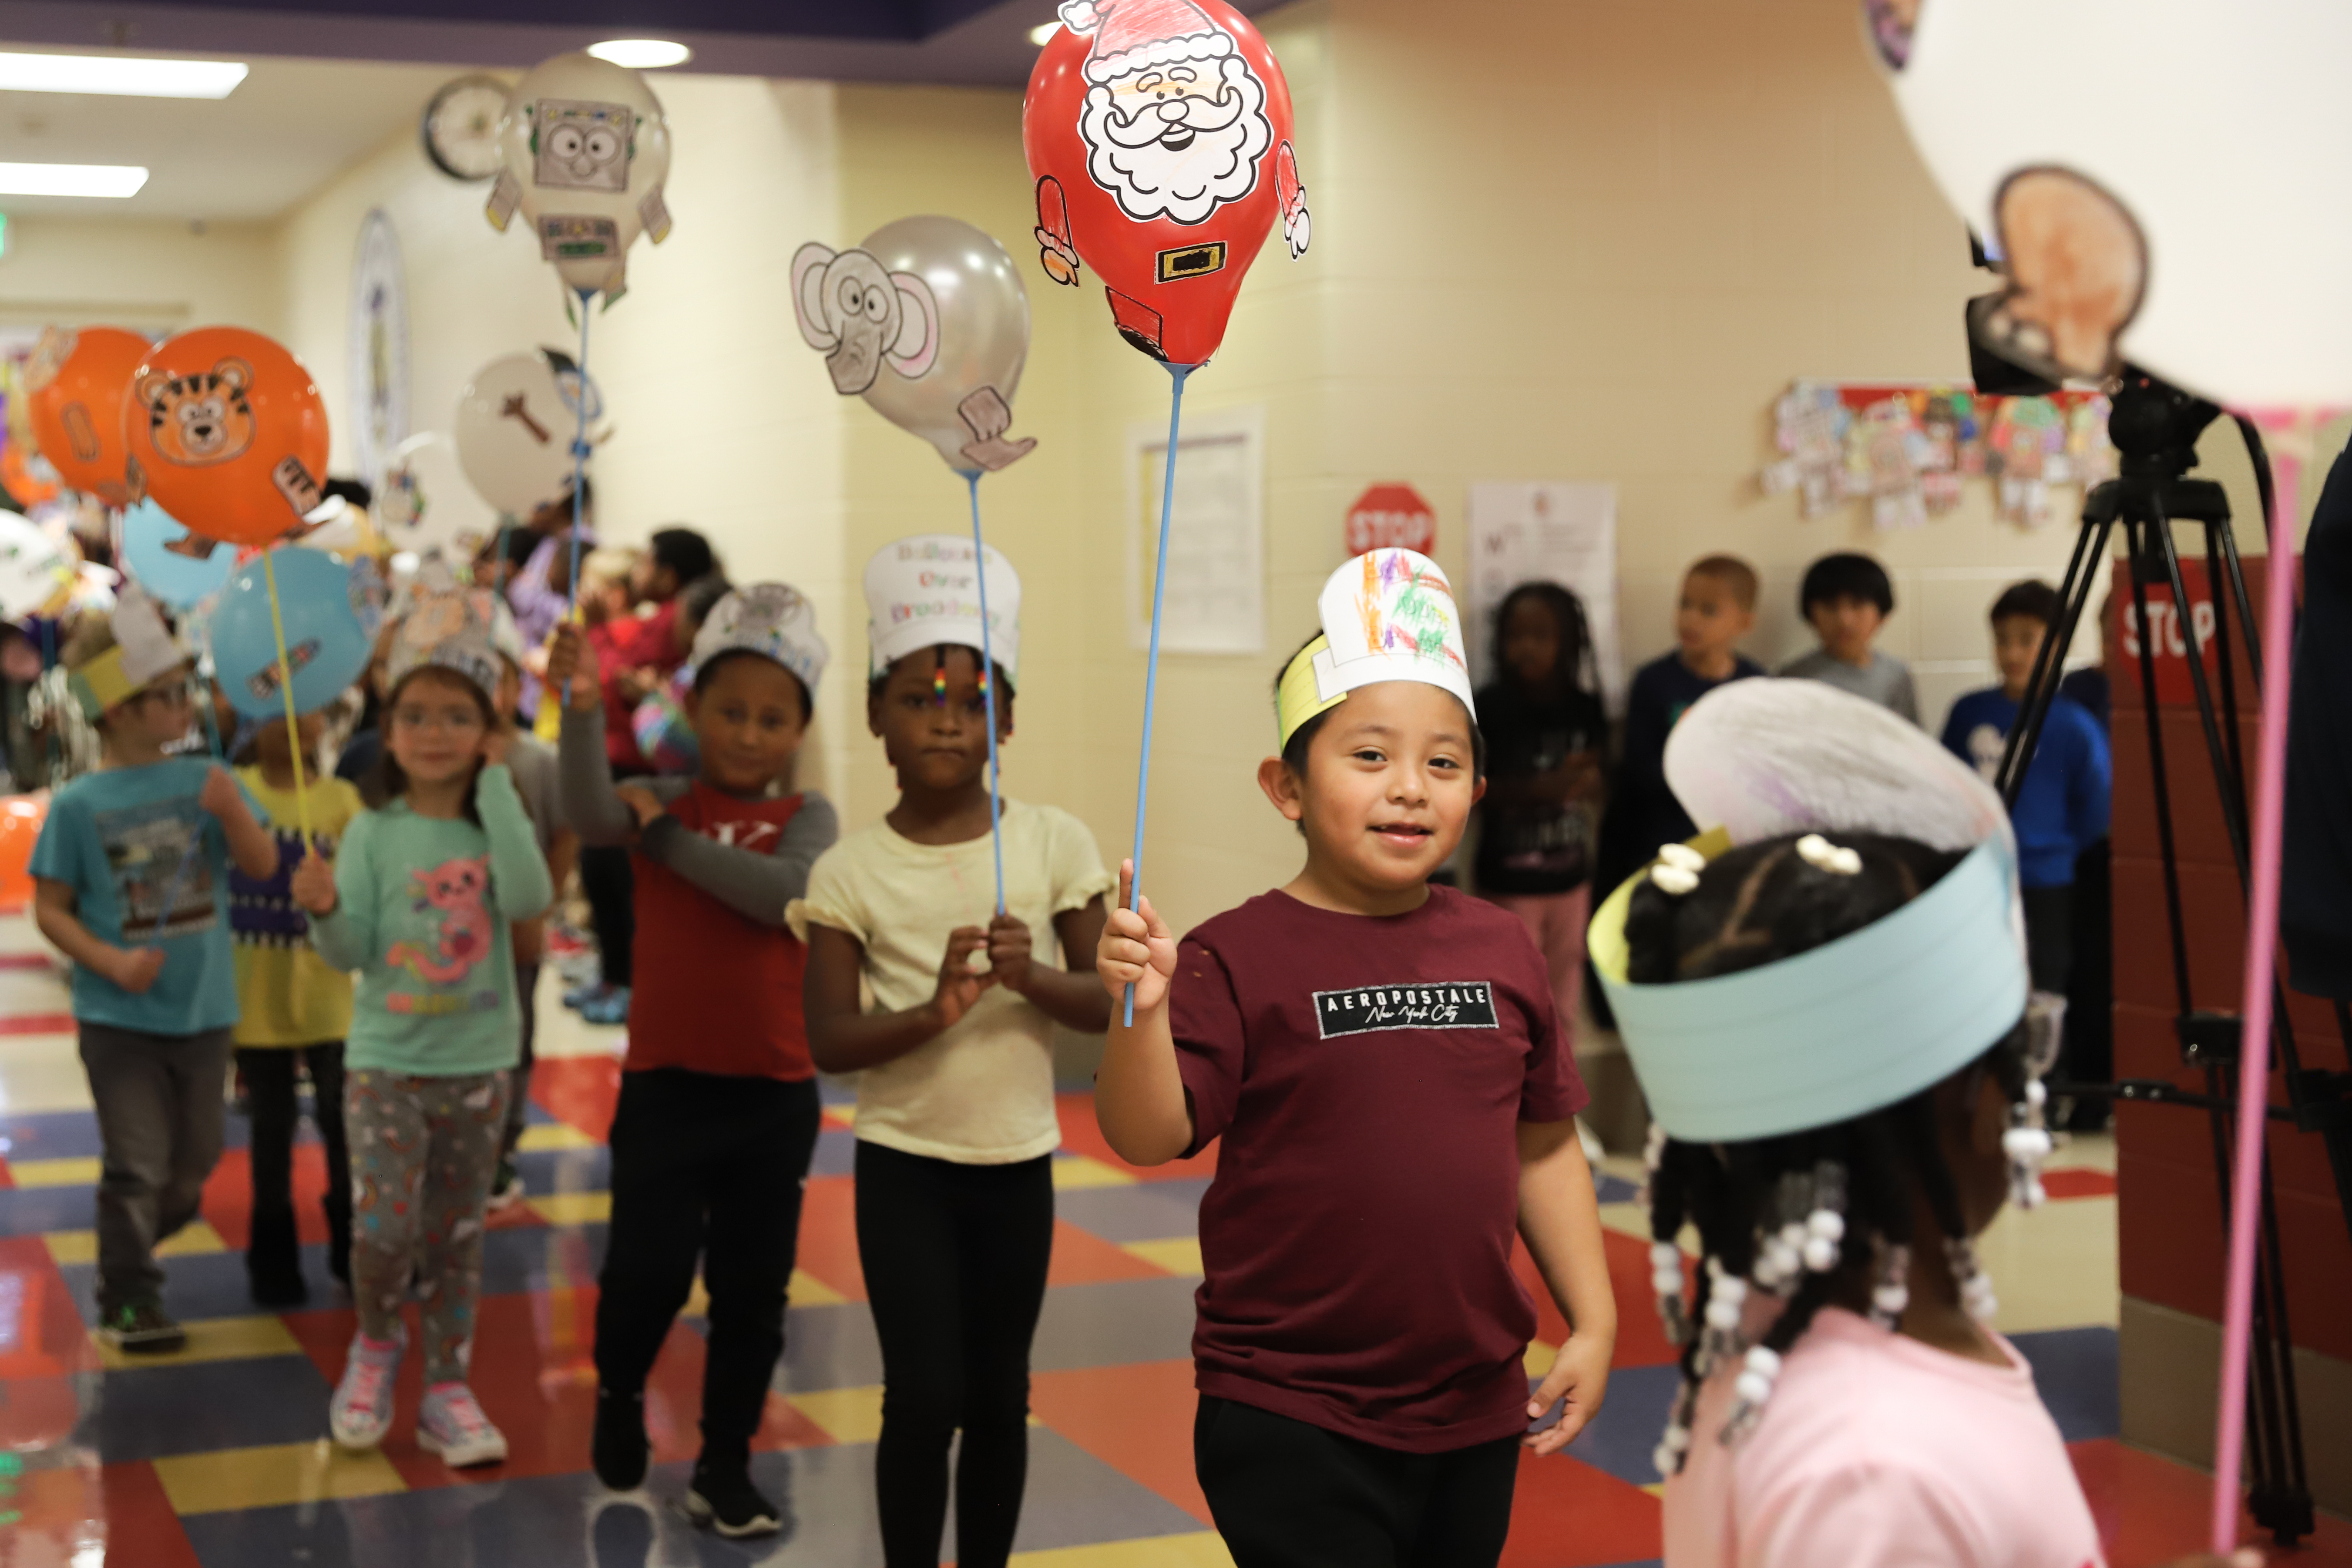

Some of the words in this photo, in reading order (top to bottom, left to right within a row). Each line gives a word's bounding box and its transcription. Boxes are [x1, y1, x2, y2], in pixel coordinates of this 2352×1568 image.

[1352, 510, 1430, 548] STOP
[1327, 988, 1486, 1012] AEROPOSTALE
[1364, 1005, 1395, 1024] New
[1398, 1005, 1428, 1024] York
[1430, 1004, 1459, 1023] City
